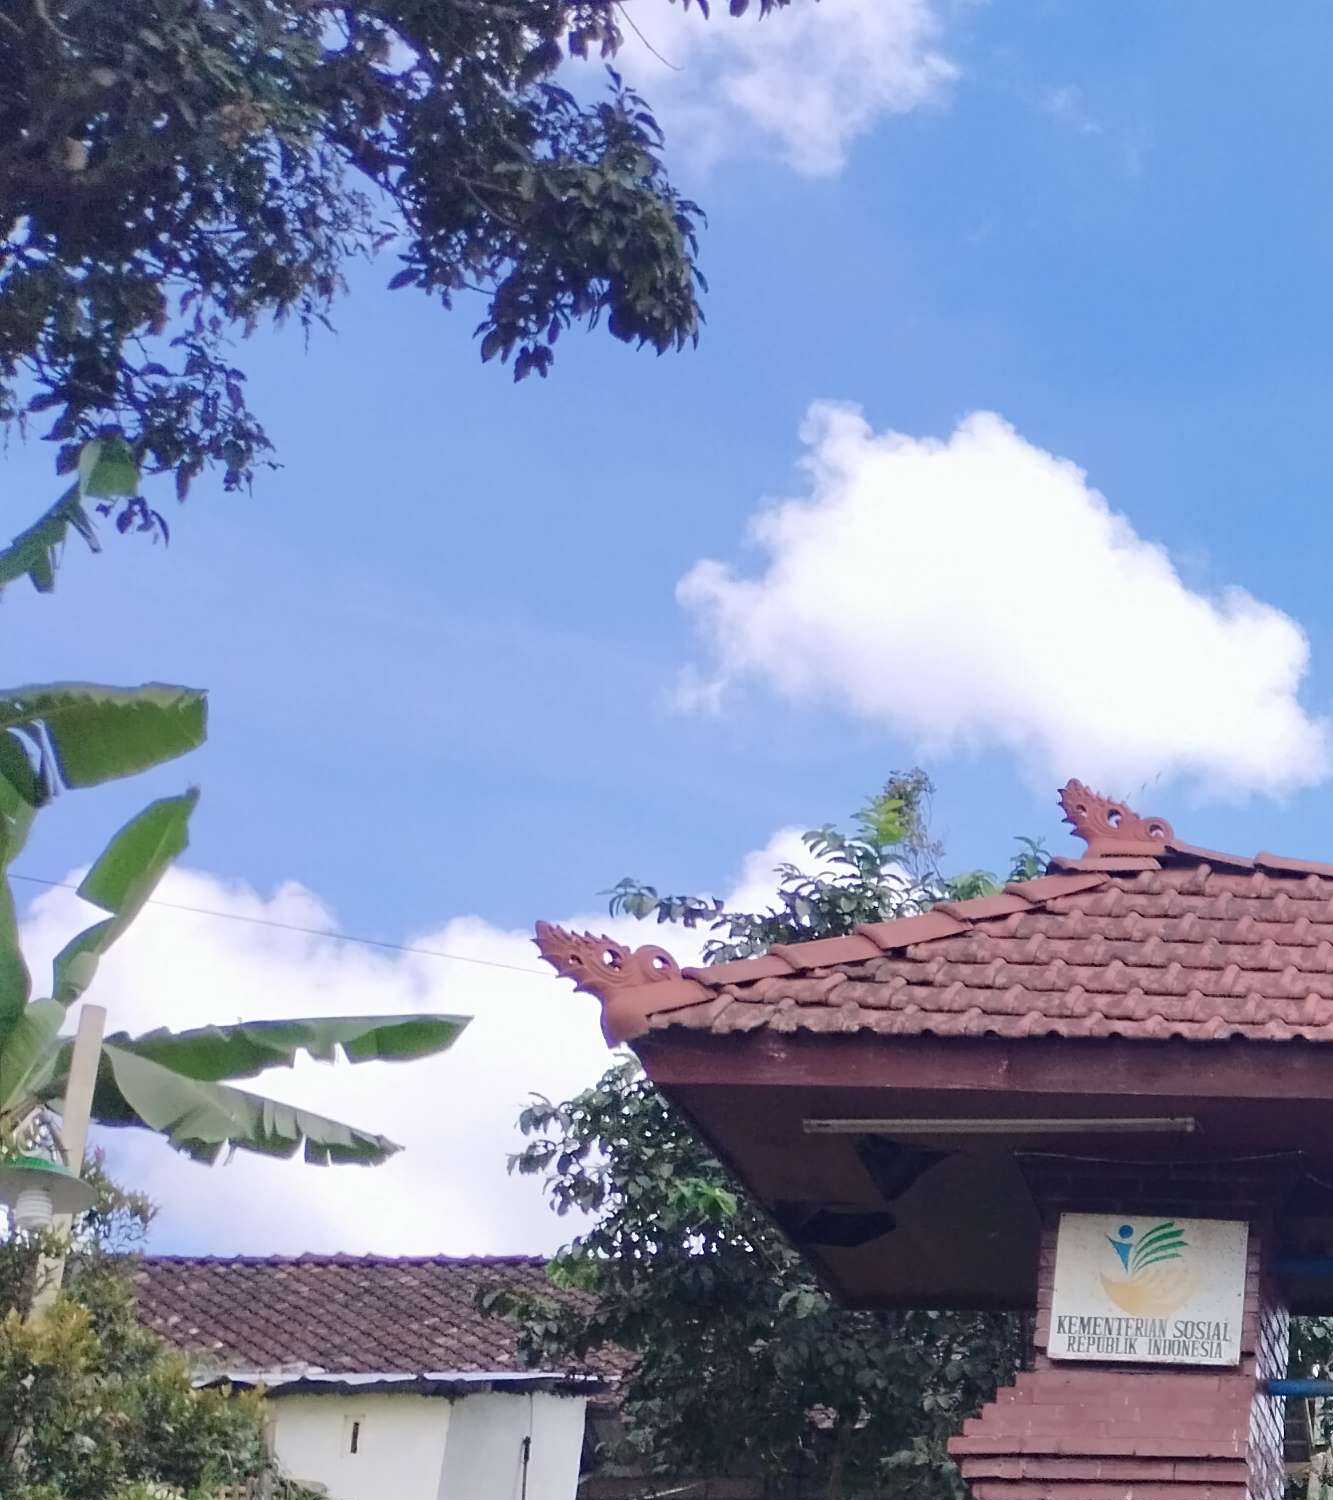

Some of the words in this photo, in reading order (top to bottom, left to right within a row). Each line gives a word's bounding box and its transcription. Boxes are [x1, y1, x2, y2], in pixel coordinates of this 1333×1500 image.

[1056, 1315, 1168, 1339] KEMENTERIAN
[1172, 1318, 1232, 1342] SOSIAL
[1066, 1335, 1139, 1355] REPUBLIK
[1147, 1338, 1223, 1359] INDONESIA
